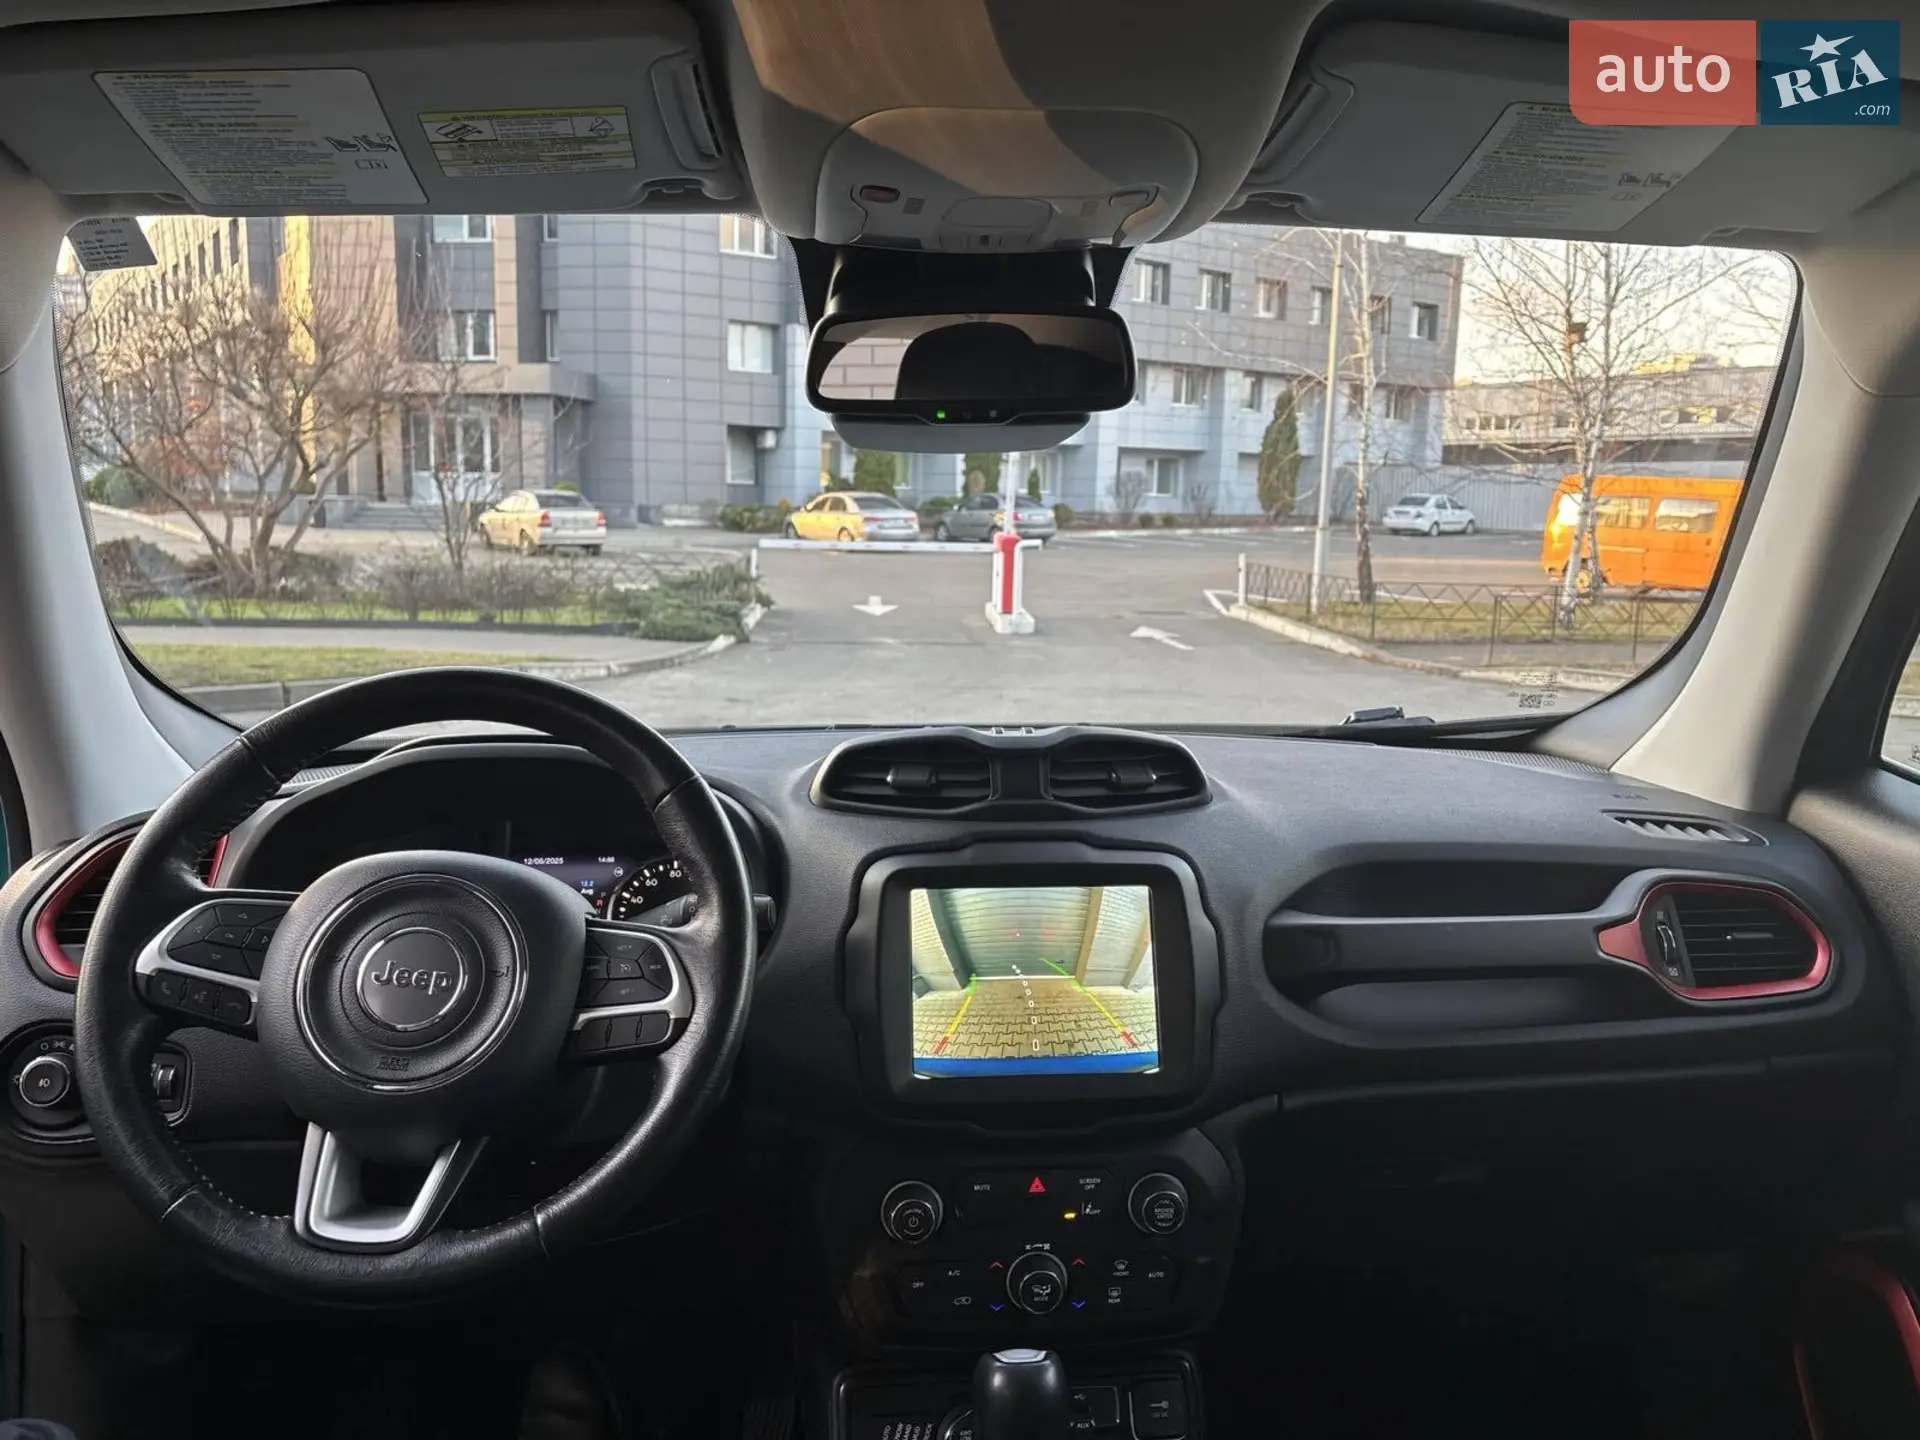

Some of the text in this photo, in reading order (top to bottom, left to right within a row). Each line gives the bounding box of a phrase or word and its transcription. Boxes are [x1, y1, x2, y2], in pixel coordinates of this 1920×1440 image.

[669, 870, 682, 878] 80
[645, 879, 659, 887] 60
[630, 896, 644, 904] 40
[371, 960, 451, 996] Jeep
[1078, 1177, 1102, 1185] SCREEN
[948, 1269, 961, 1277] A/C
[1076, 1421, 1090, 1429] AUX
